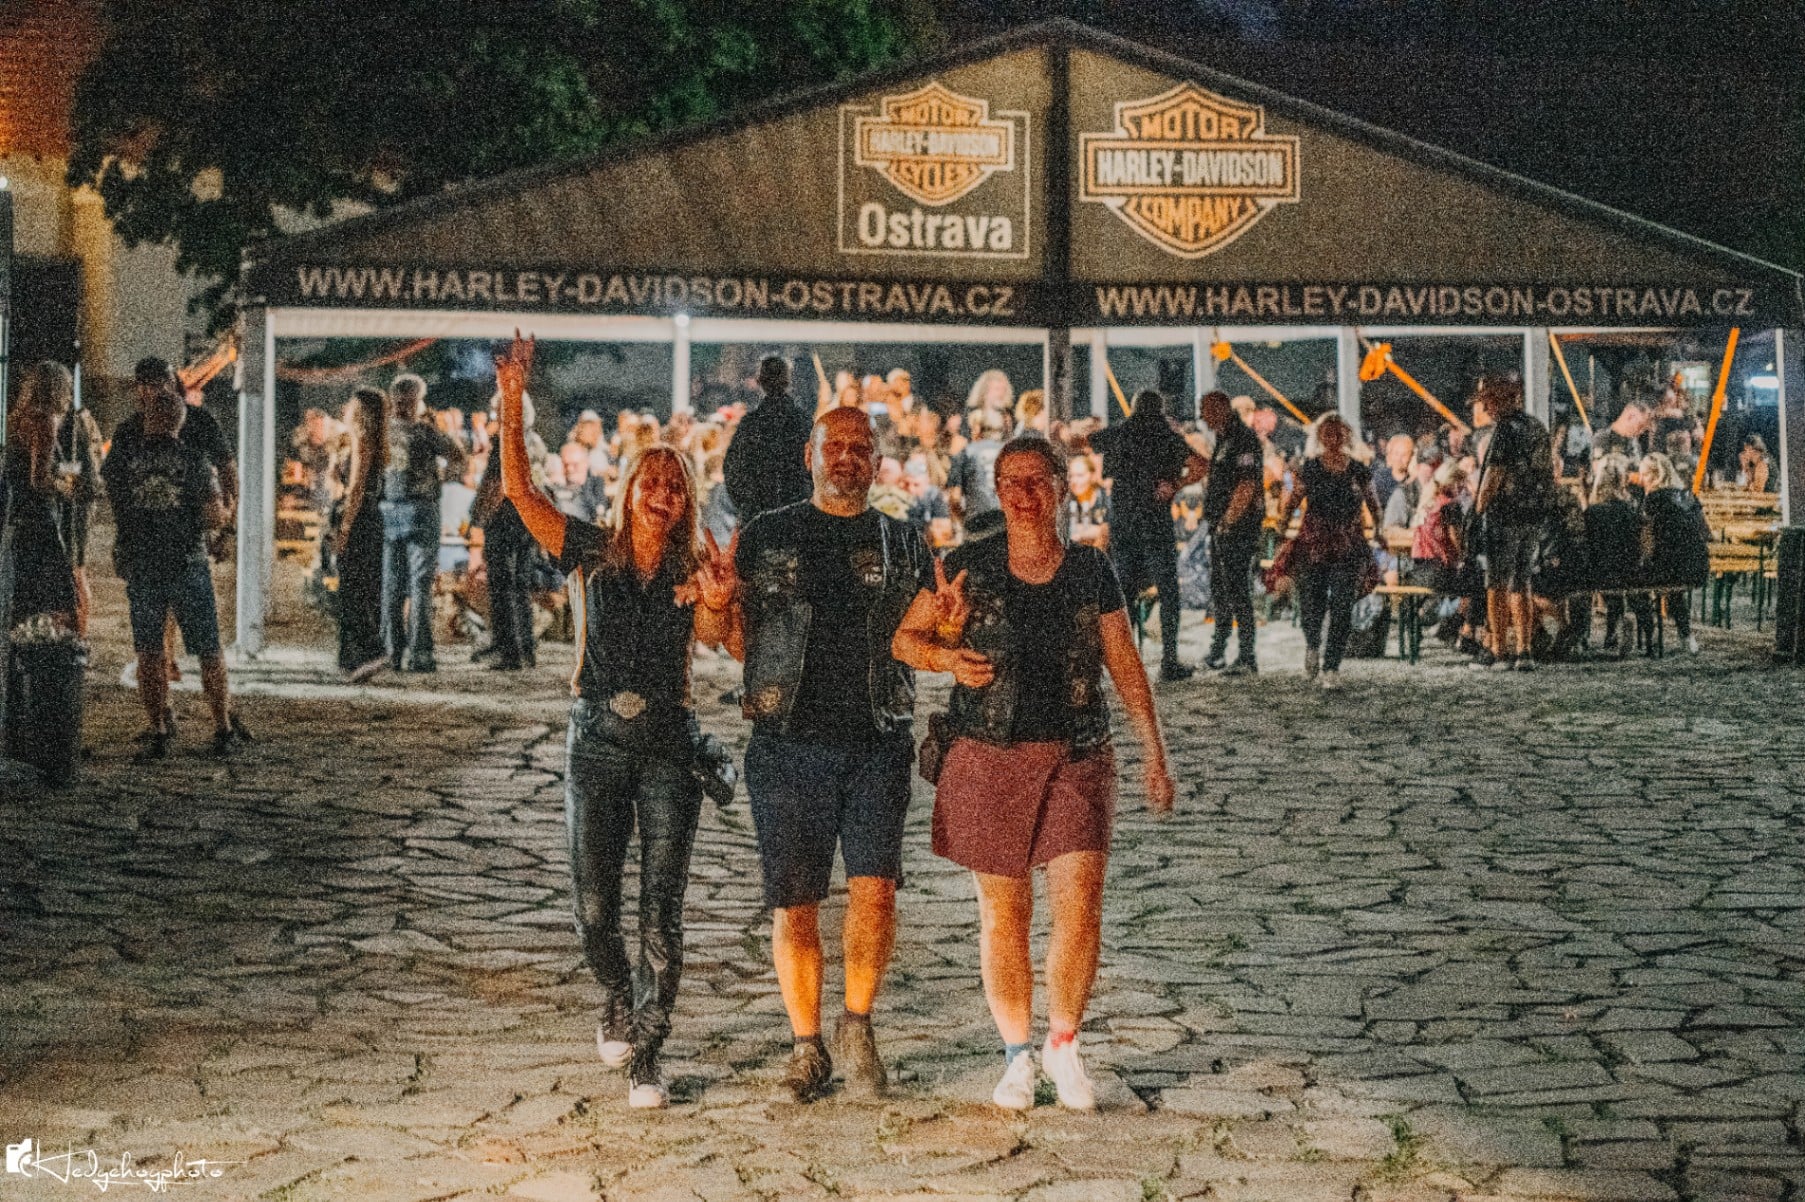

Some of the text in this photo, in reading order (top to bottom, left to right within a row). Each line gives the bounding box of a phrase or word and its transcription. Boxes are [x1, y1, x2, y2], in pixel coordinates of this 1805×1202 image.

[901, 100, 970, 124] MOTOR
[1140, 101, 1241, 139] MOTOR
[1097, 149, 1285, 187] HARLEY-DAVIDSON
[858, 202, 1013, 250] Ostrava
[1141, 196, 1242, 241] COMPANY
[297, 265, 1015, 315] WWW.HARLEY-DAVIDSON-OSTRAVA.CZ
[1095, 286, 1755, 318] WWW.HARLEY-DAVIDSON-OSTRAVA.CZ
